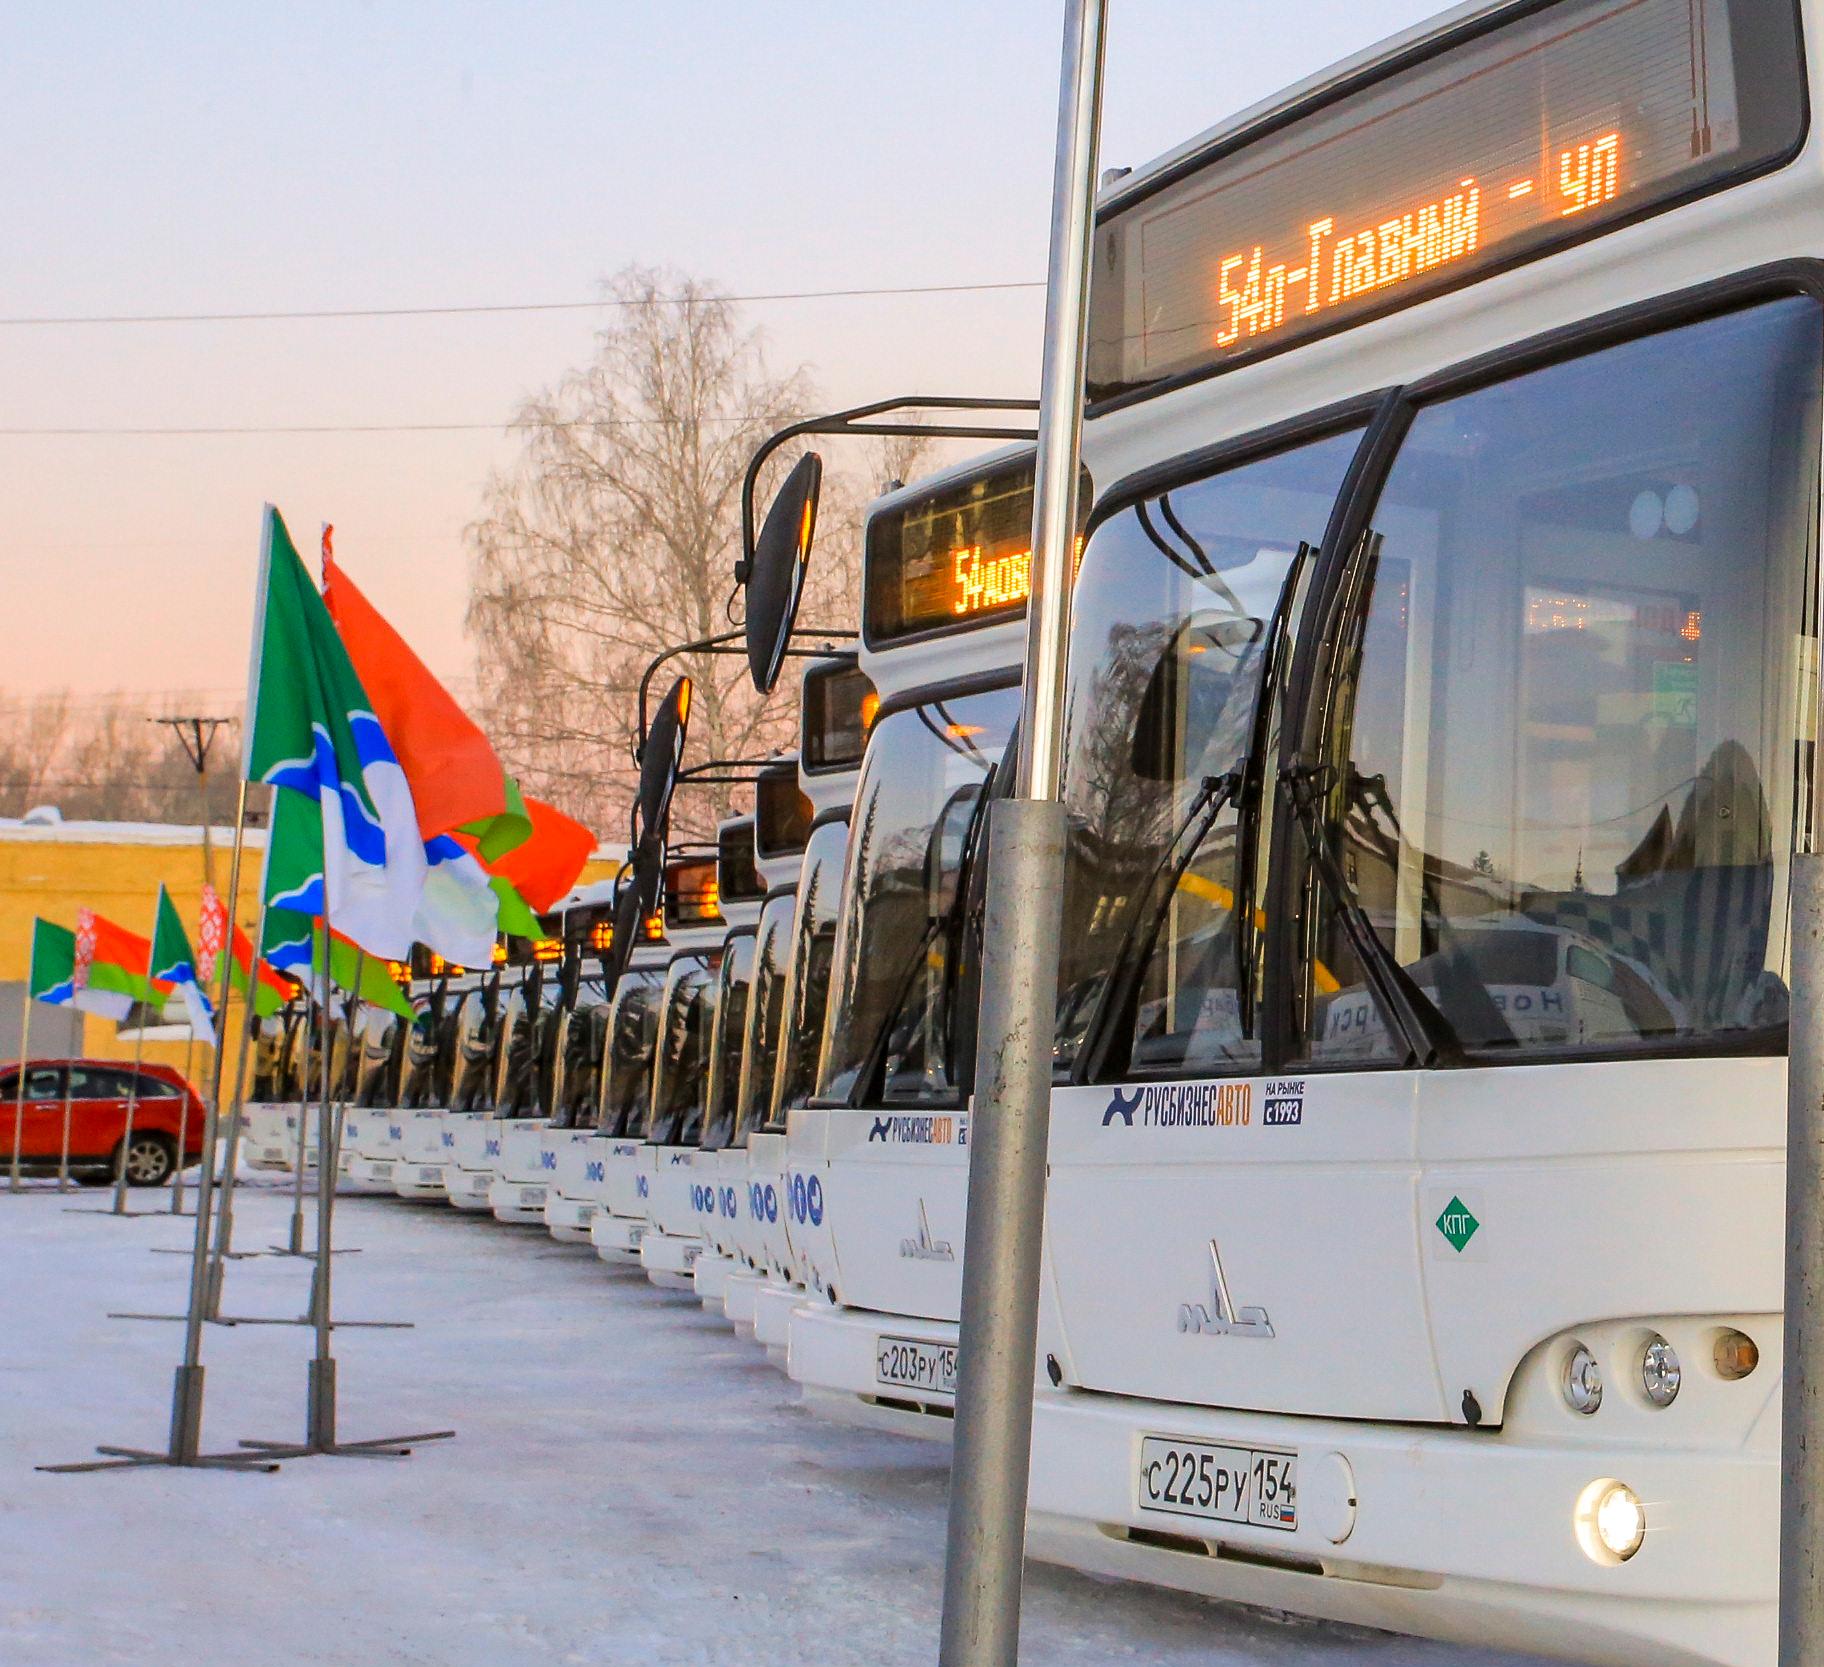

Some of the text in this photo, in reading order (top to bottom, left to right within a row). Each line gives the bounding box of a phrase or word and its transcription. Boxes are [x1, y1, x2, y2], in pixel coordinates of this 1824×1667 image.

[1265, 1082, 1304, 1095] НА РЫНКЕ
[1143, 1084, 1252, 1126] РУСБИЗНЕСАВТО
[1442, 1213, 1470, 1236] КПГ
[1254, 1458, 1293, 1504] 154
[1259, 1503, 1280, 1519] RUS
